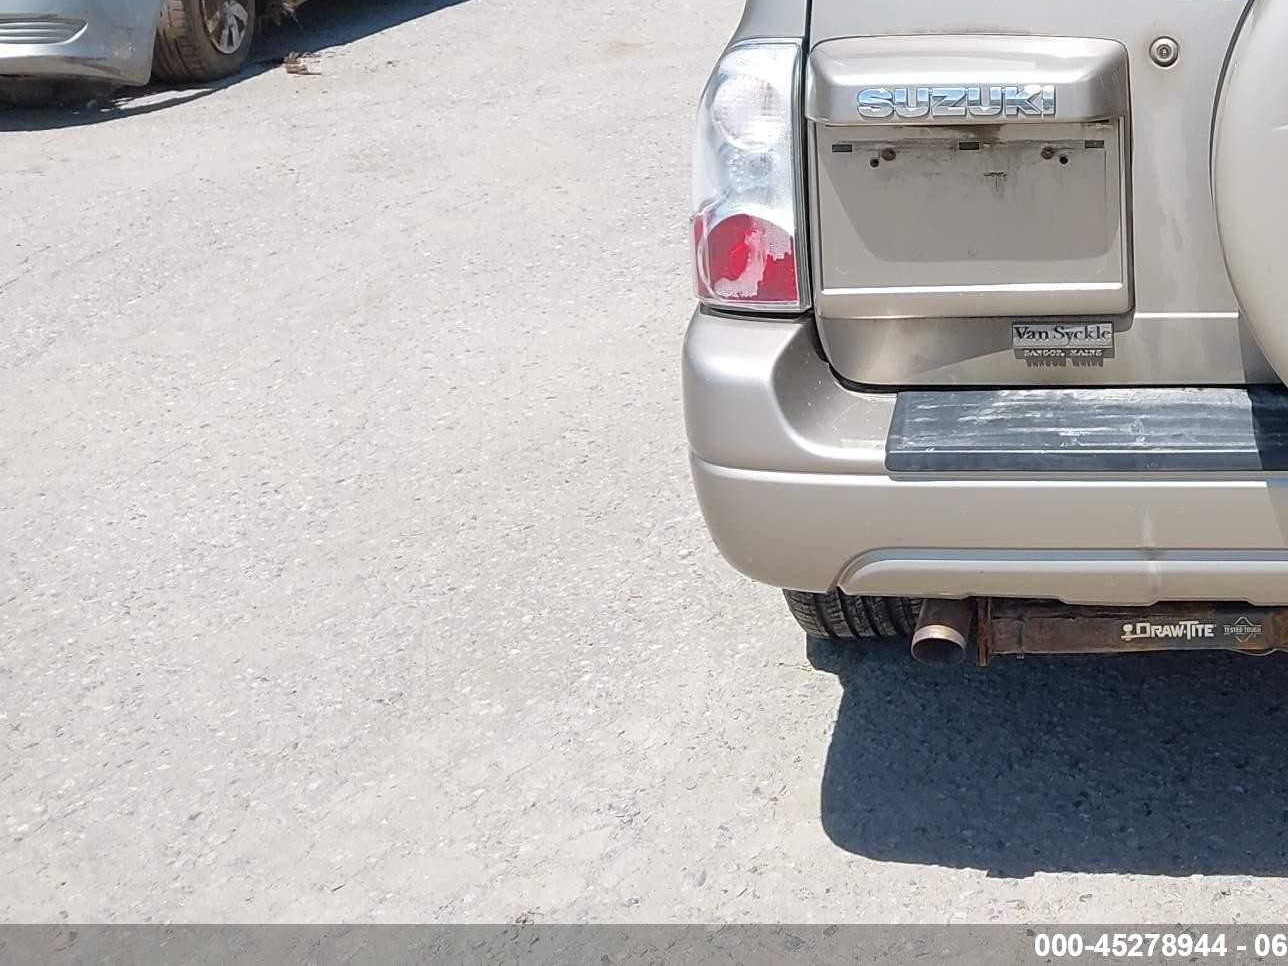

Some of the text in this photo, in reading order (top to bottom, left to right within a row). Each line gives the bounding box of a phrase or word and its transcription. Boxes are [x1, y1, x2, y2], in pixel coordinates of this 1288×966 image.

[857, 86, 1056, 119] SUZUKI
[1014, 325, 1111, 347] Van Syckle
